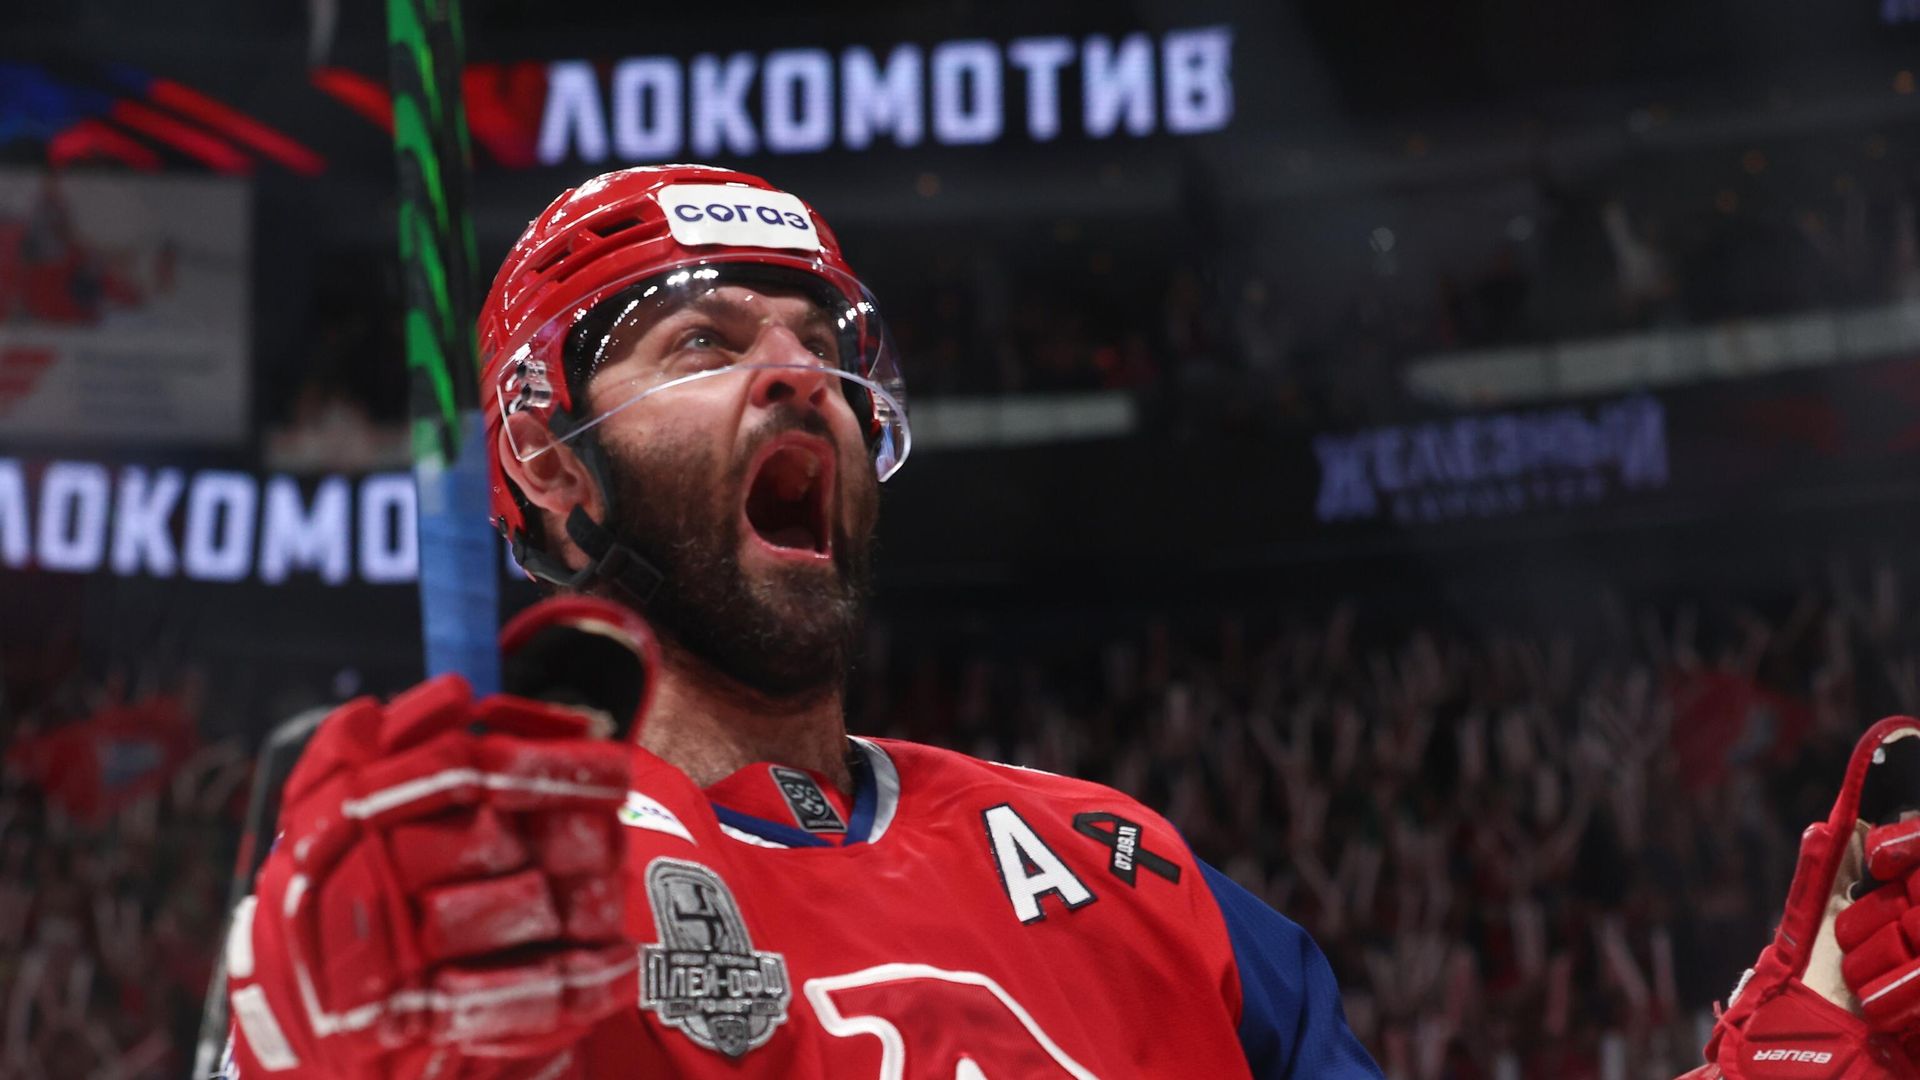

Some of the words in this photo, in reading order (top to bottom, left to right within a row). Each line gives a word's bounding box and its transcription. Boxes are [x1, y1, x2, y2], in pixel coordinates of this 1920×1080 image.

[538, 27, 1233, 165] ЛОКОМОТИВ
[0, 456, 523, 584] ЛОКОМО
[980, 803, 1097, 924] A
[1114, 826, 1137, 871] 07.09.11
